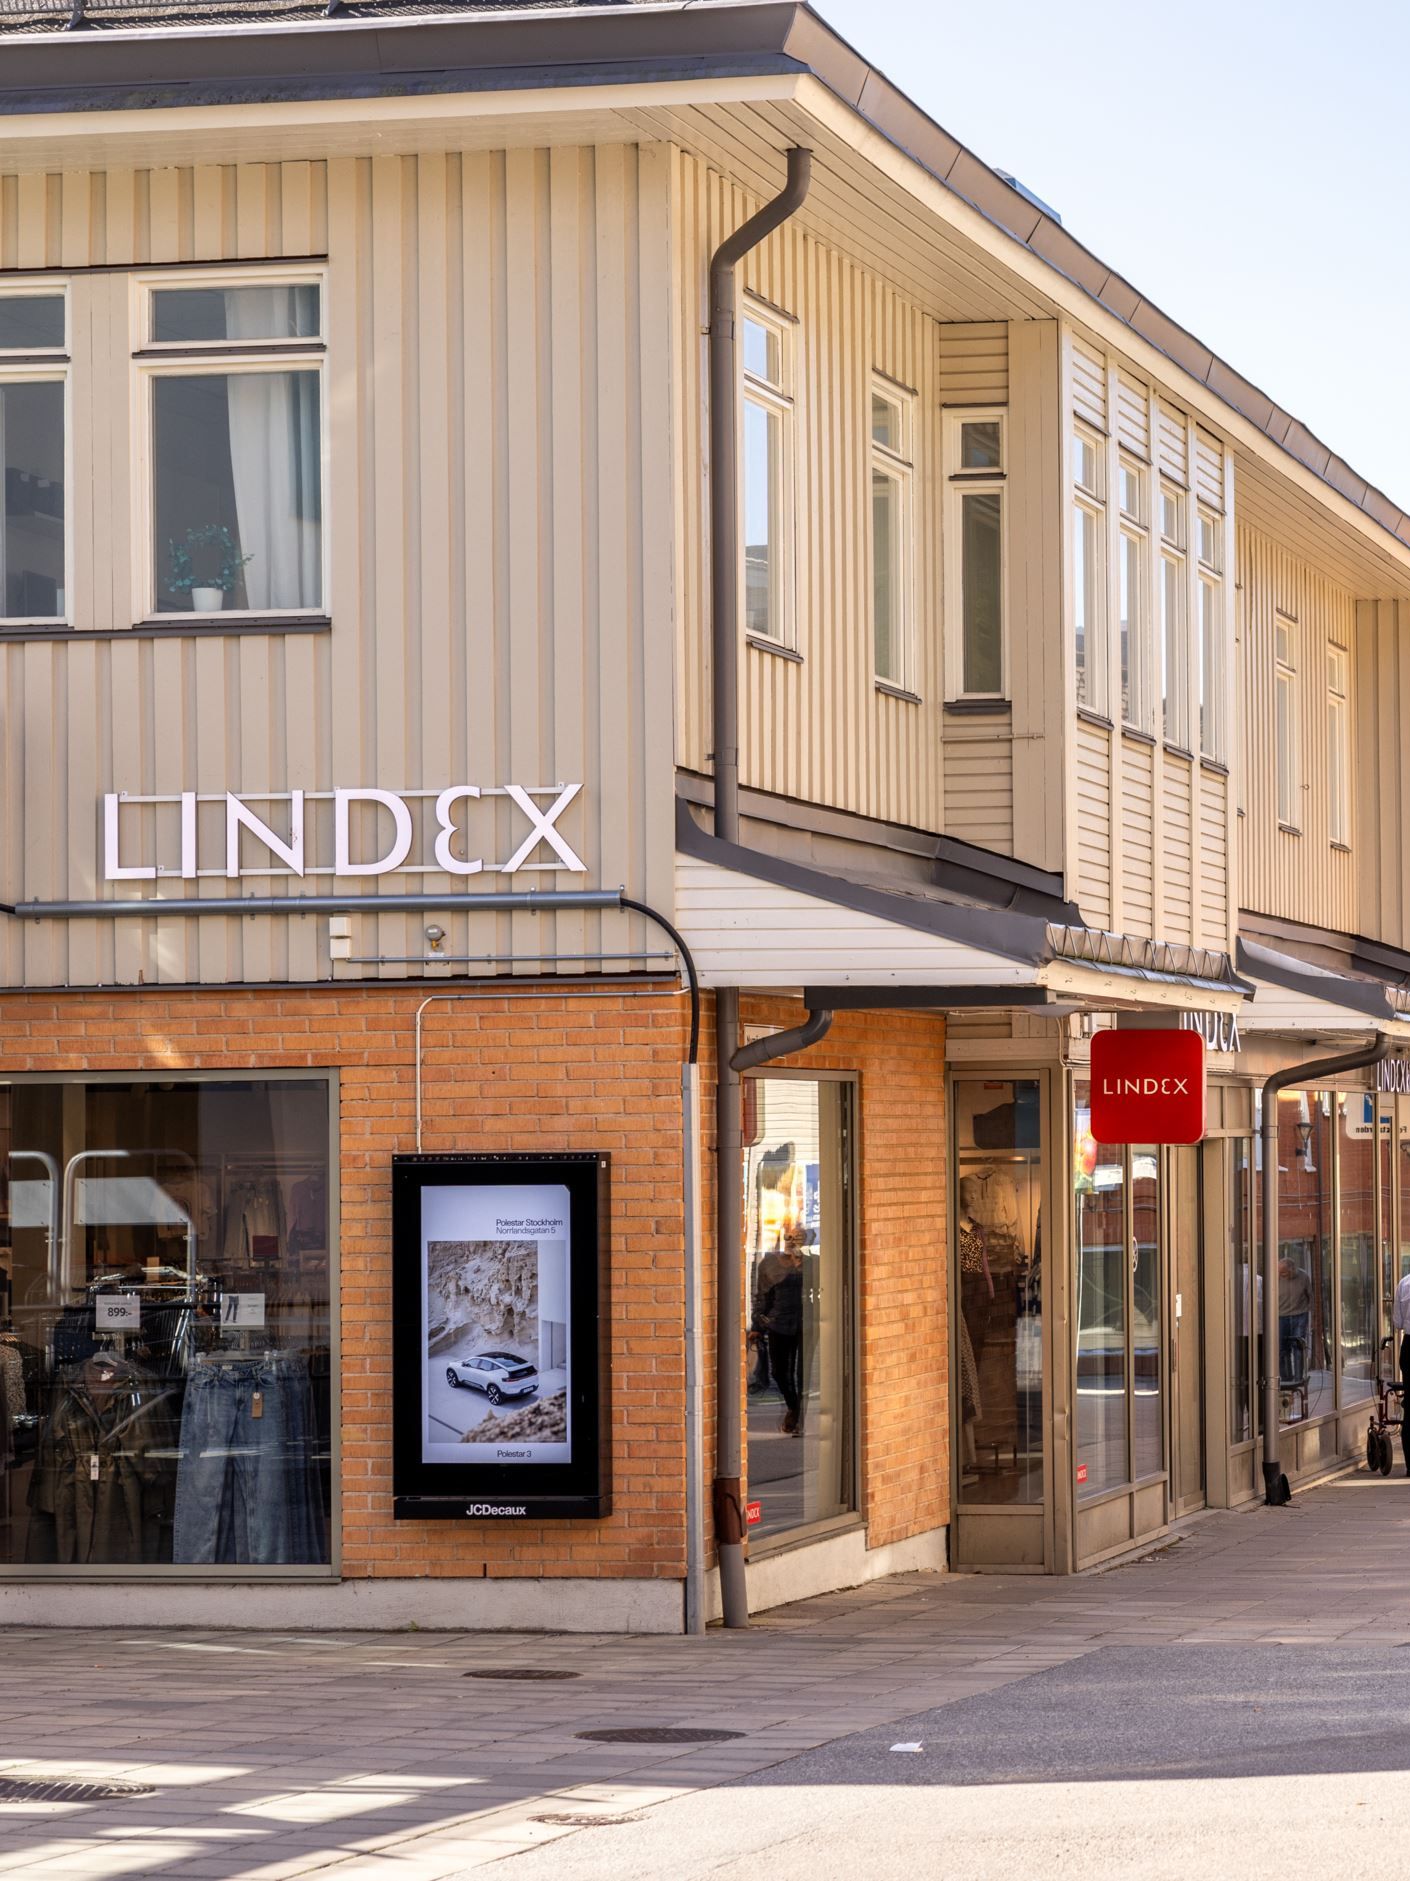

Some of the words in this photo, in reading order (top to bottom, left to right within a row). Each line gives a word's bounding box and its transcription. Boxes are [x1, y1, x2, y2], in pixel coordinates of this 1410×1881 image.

[104, 783, 589, 879] LINDEX
[1103, 1078, 1189, 1095] LINDEX
[495, 1218, 524, 1227] Polestar
[525, 1218, 563, 1227] Stockholm
[495, 1226, 550, 1236] Norrlandsgatan
[550, 1226, 556, 1234] 5
[107, 1306, 132, 1317] 899:-
[496, 1449, 526, 1458] Polestar
[526, 1450, 532, 1458] 3
[466, 1504, 526, 1516] JCDecaux
